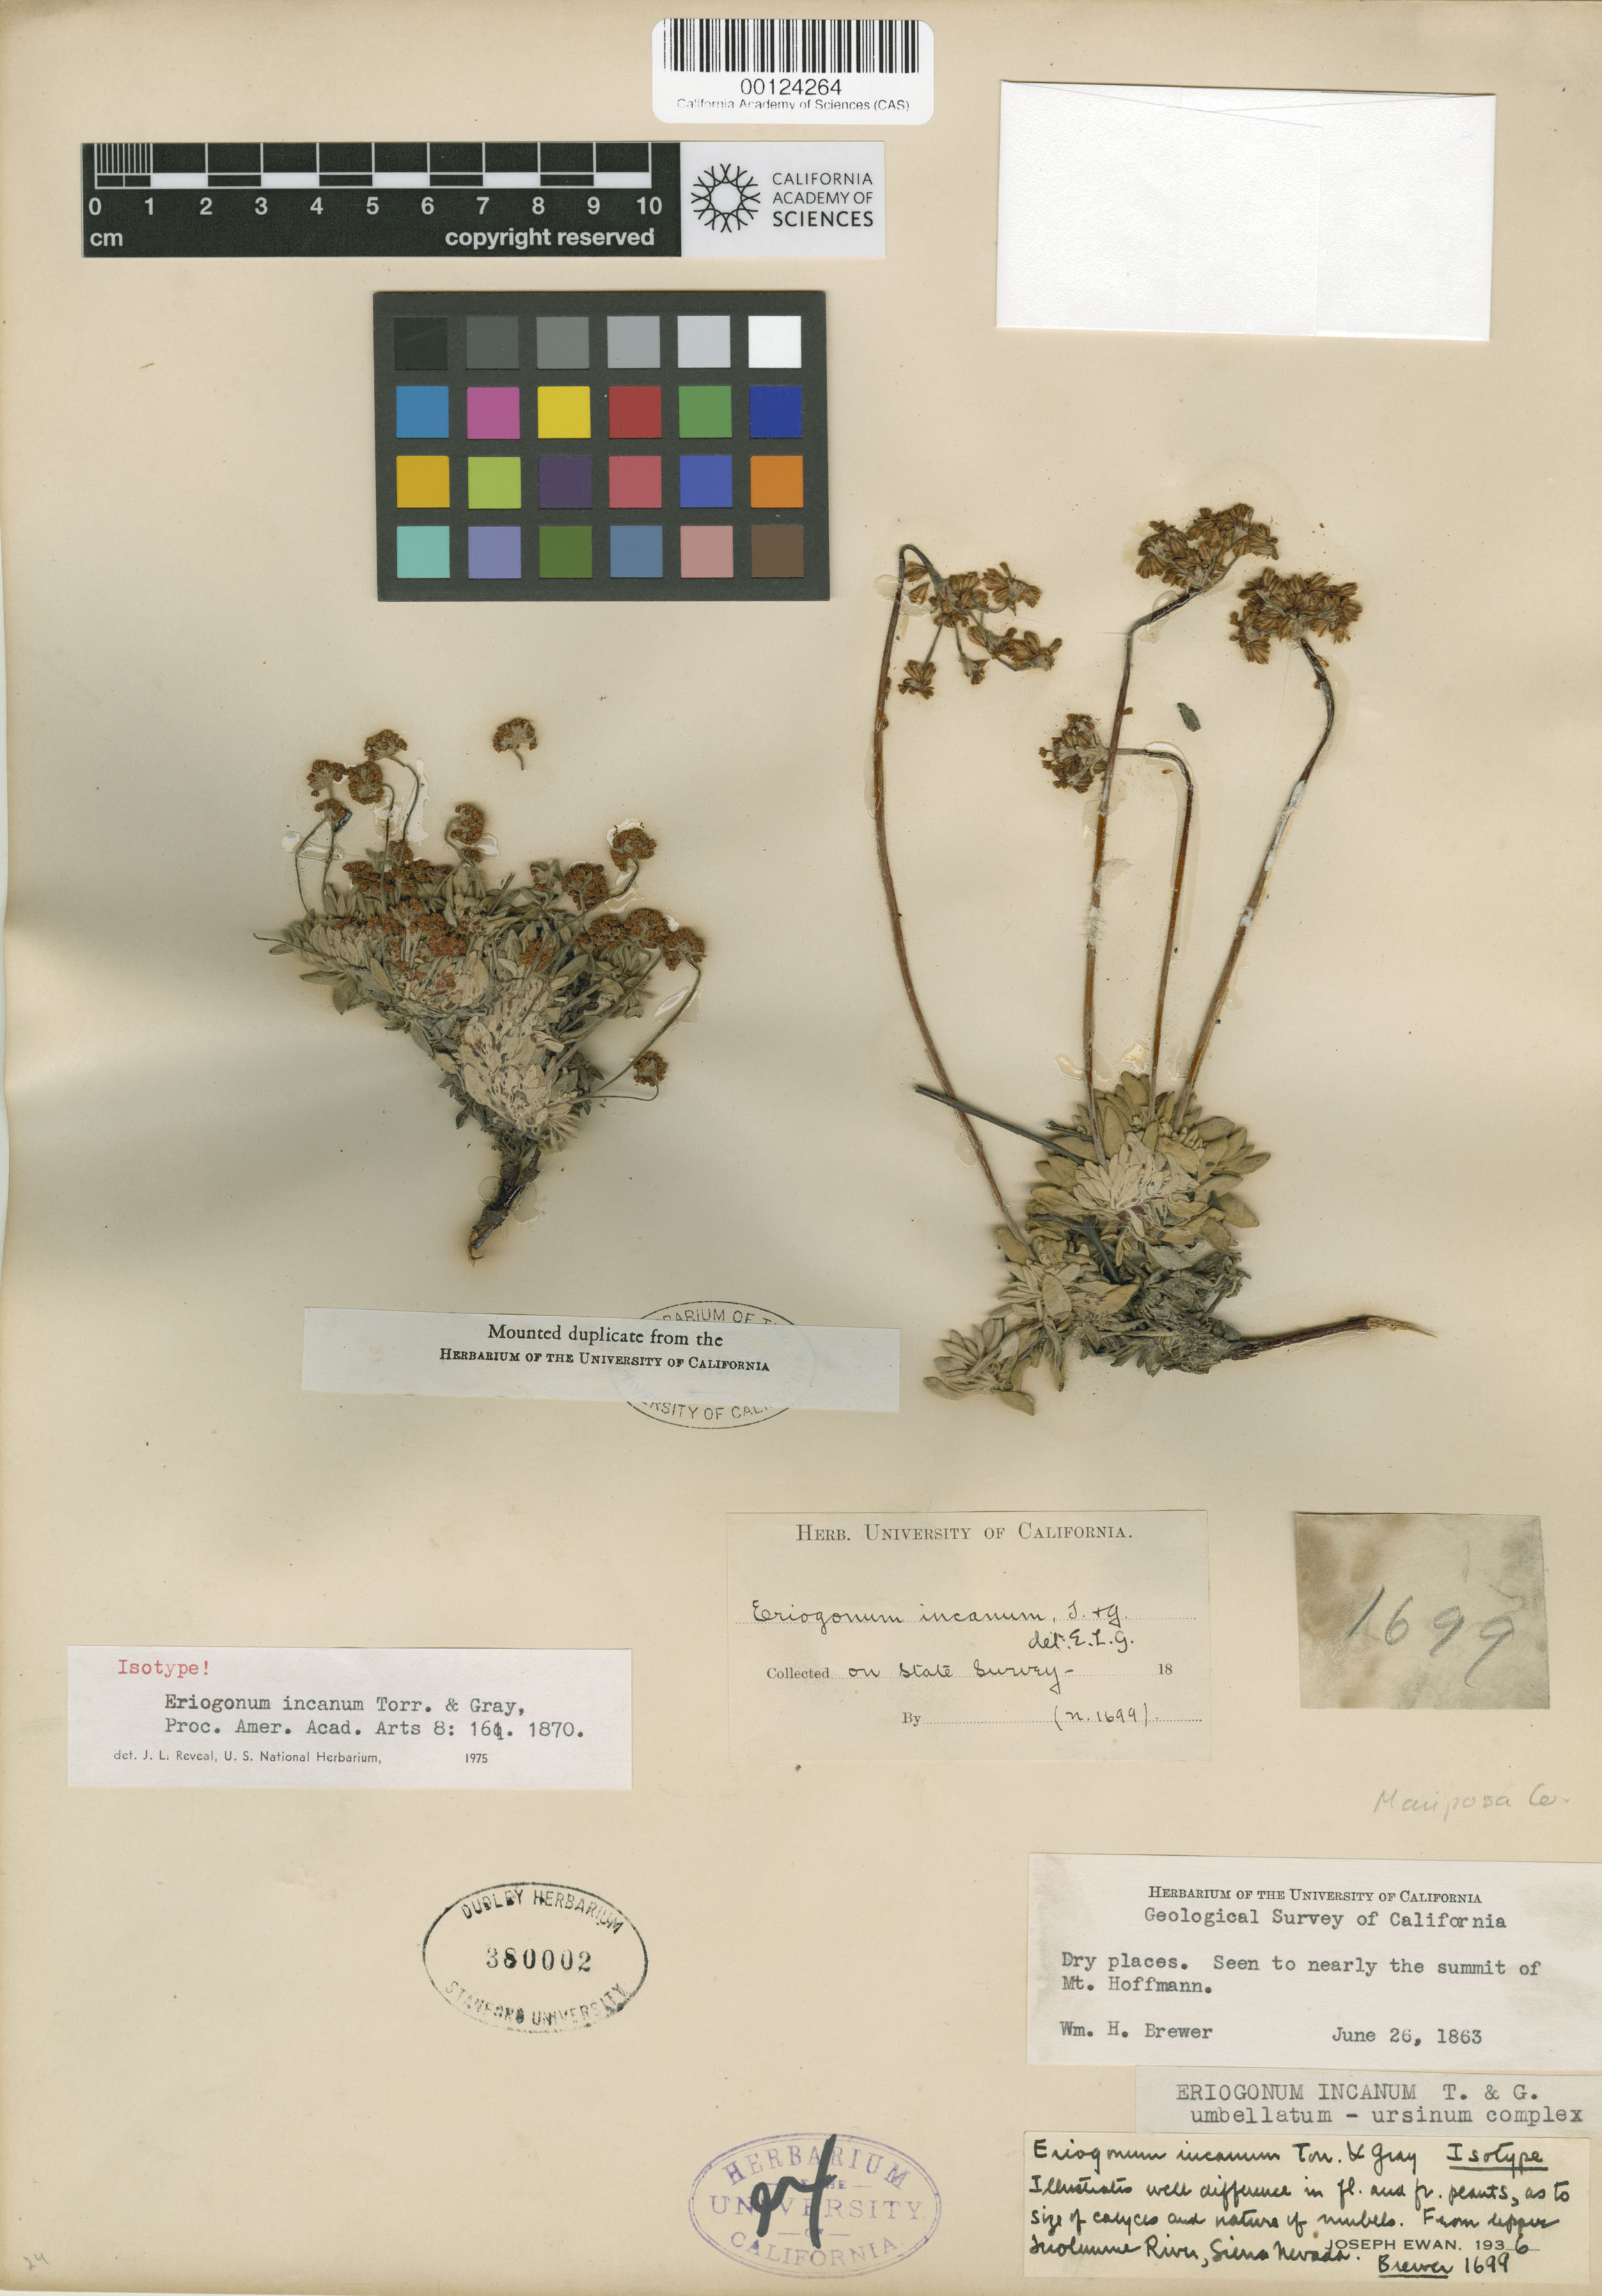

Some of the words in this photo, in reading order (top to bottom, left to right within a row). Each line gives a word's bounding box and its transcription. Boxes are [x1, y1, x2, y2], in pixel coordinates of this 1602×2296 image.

[740, 78, 842, 95] 00124264
[739, 98, 796, 110] Academy
[799, 99, 811, 109] of
[815, 99, 870, 110] Sciences
[874, 99, 910, 111] (CAS)
[772, 172, 873, 185] CALIFORNIA
[88, 196, 102, 216] 0
[144, 197, 154, 216] 1
[199, 196, 213, 215] 2
[255, 196, 268, 215] 3
[310, 196, 324, 215] 4
[366, 196, 379, 215] 5
[421, 196, 434, 215] 6
[476, 196, 490, 215] 7
[531, 196, 545, 215] 8
[587, 196, 601, 215] 9
[636, 196, 663, 215] 10
[772, 192, 850, 205] ACADEMY
[853, 192, 873, 205] OF
[773, 210, 874, 227] SCIENCES
[90, 232, 123, 247] cm
[445, 227, 552, 251] copyright
[557, 227, 654, 246] reserved
[487, 1323, 562, 1341] Mounted
[568, 1325, 644, 1346] duplicate
[650, 1328, 689, 1345] from
[696, 1331, 723, 1347] the
[439, 1348, 521, 1362] HERBARIUM
[525, 1352, 542, 1363] OF
[545, 1353, 574, 1364] THE
[579, 1352, 663, 1367] UNIVERSITY
[667, 1358, 684, 1368] OF
[688, 1356, 770, 1372] CALIFORNIA
[703, 1407, 725, 1421] OF
[796, 1524, 851, 1541] HERB.
[863, 1524, 971, 1541] UNIVERSITY
[984, 1527, 1005, 1540] OF
[1018, 1522, 1133, 1540] CALIFORNIA.
[752, 1599, 905, 1636] Eriogonum
[1345, 1584, 1516, 1688] 1699
[118, 1659, 208, 1679] Isotype!
[767, 1666, 830, 1680] Collected
[848, 1666, 881, 1678] on
[1158, 1663, 1173, 1676] 18
[164, 1694, 272, 1713] Eriogonum
[282, 1695, 365, 1711] incanum
[376, 1696, 432, 1713] Torr.
[445, 1697, 459, 1712] &
[470, 1698, 524, 1717] Gray,
[164, 1717, 221, 1734] Proc.
[234, 1718, 292, 1735] Amer.
[305, 1719, 361, 1736] Acad.
[375, 1720, 421, 1735] Arts
[433, 1720, 455, 1737] 8:
[528, 1721, 584, 1739] 1870.
[902, 1712, 922, 1728] By
[113, 1749, 137, 1760] det.
[142, 1749, 153, 1760] J.
[176, 1749, 217, 1763] Reveal,
[224, 1750, 237, 1761] U.
[242, 1750, 253, 1761] S.
[260, 1751, 310, 1763] National
[317, 1751, 382, 1765] Herbarium,
[466, 1753, 488, 1764] 1975
[1148, 1885, 1232, 1900] HERBARIUM
[1236, 1889, 1253, 1900] OF
[1257, 1890, 1286, 1900] THE
[1289, 1888, 1374, 1902] UNIVERSITY
[1379, 1892, 1396, 1903] OF
[1399, 1889, 1482, 1904] CALIFORNIA
[460, 1888, 524, 1920] DUDLEY
[533, 1889, 624, 1935] HERBARIUM
[1145, 1907, 1259, 1927] Geological
[1272, 1908, 1344, 1930] Survey
[1356, 1910, 1379, 1926] of
[1390, 1912, 1507, 1929] California
[487, 1948, 591, 1972] 380002
[1061, 1951, 1097, 1972] Dry
[1108, 1952, 1188, 1972] places.
[1214, 1954, 1260, 1971] Seen
[1271, 1955, 1296, 1971] to
[1307, 1957, 1378, 1978] nearly
[1389, 1958, 1424, 1974] the
[1437, 1959, 1506, 1975] summit
[1519, 1960, 1541, 1976] of
[1062, 1974, 1094, 1992] Mt.
[1108, 1976, 1212, 1994] Hoffmann.
[1059, 2020, 1094, 2038] Wm.
[1107, 2020, 1129, 2038] H.
[1145, 2022, 1214, 2040] Brewer
[1331, 2026, 1376, 2043] June
[1390, 2027, 1422, 2047] 26,
[1437, 2028, 1482, 2045] 1863
[1176, 2084, 1305, 2102] ERIOGONUM
[1318, 2083, 1417, 2100] INCANUM
[1443, 2083, 1468, 2100] T.
[1484, 2084, 1500, 2100] &
[1513, 2084, 1538, 2100] G.
[1190, 2106, 1333, 2125] umbellatum
[1371, 2105, 1473, 2123] ursinum
[1486, 2107, 1584, 2127] complex
[1372, 2143, 1417, 2176] Gray
[1447, 2142, 1548, 2178] Isotype
[1304, 2176, 1323, 2198] in
[1371, 2185, 1406, 2196] and
[1554, 2181, 1569, 2202] to
[1424, 2208, 1479, 2228] From
[730, 2231, 898, 2267] CALIFORNIA
[1324, 2239, 1396, 2251] JOSEPH
[1404, 2239, 1462, 2251] EWAN.
[1379, 2254, 1454, 2279] Brewer
[1466, 2252, 1509, 2274] 1699
